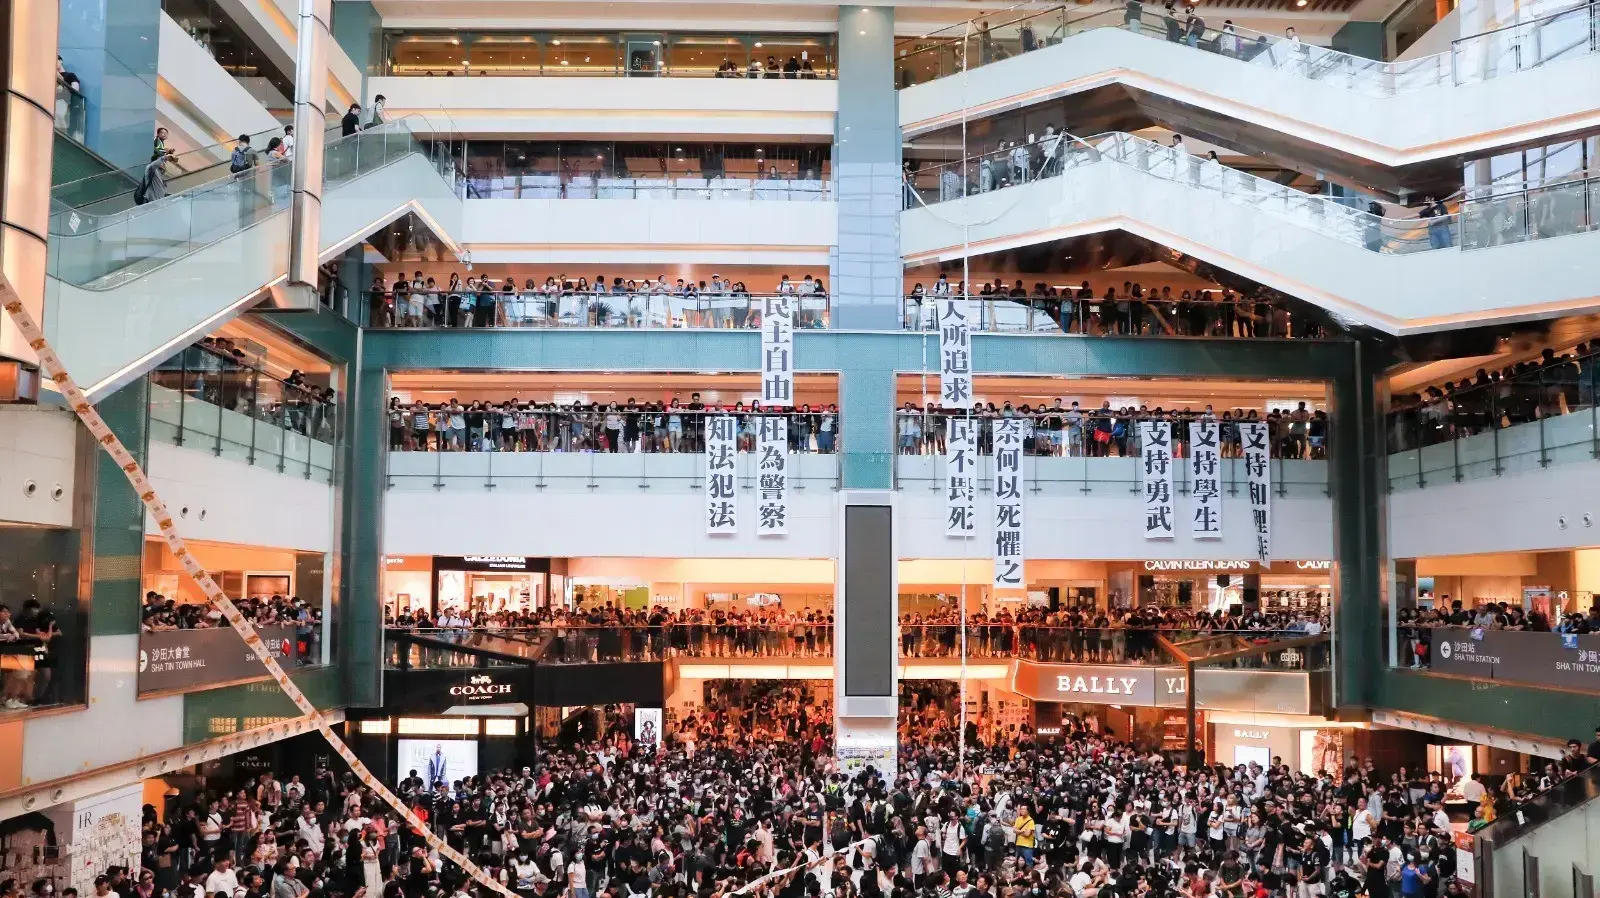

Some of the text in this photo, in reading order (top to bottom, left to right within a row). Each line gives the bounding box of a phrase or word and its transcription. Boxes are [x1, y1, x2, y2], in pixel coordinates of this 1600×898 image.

[763, 297, 790, 401] 民主自由
[941, 301, 969, 403] 人所追求
[708, 417, 735, 528] 知法犯法
[948, 418, 974, 530] 民不畏死
[1143, 422, 1172, 532] 支持勇武
[1192, 422, 1219, 532] 支持學生
[995, 420, 1022, 584] 奈何以死懼之
[1145, 560, 1250, 570] CALVIN KLEIN JEANS
[151, 646, 190, 661] 沙田大會堂
[1453, 641, 1475, 653] 沙田站
[151, 660, 206, 673] SHA TIN TOWN HALL
[1454, 653, 1500, 664] SHA TIN STATION
[1556, 662, 1571, 670] SHA
[1572, 663, 1584, 672] TIN
[449, 684, 511, 696] COACH
[1056, 675, 1138, 695] BALLY
[1234, 729, 1270, 739] BALLY
